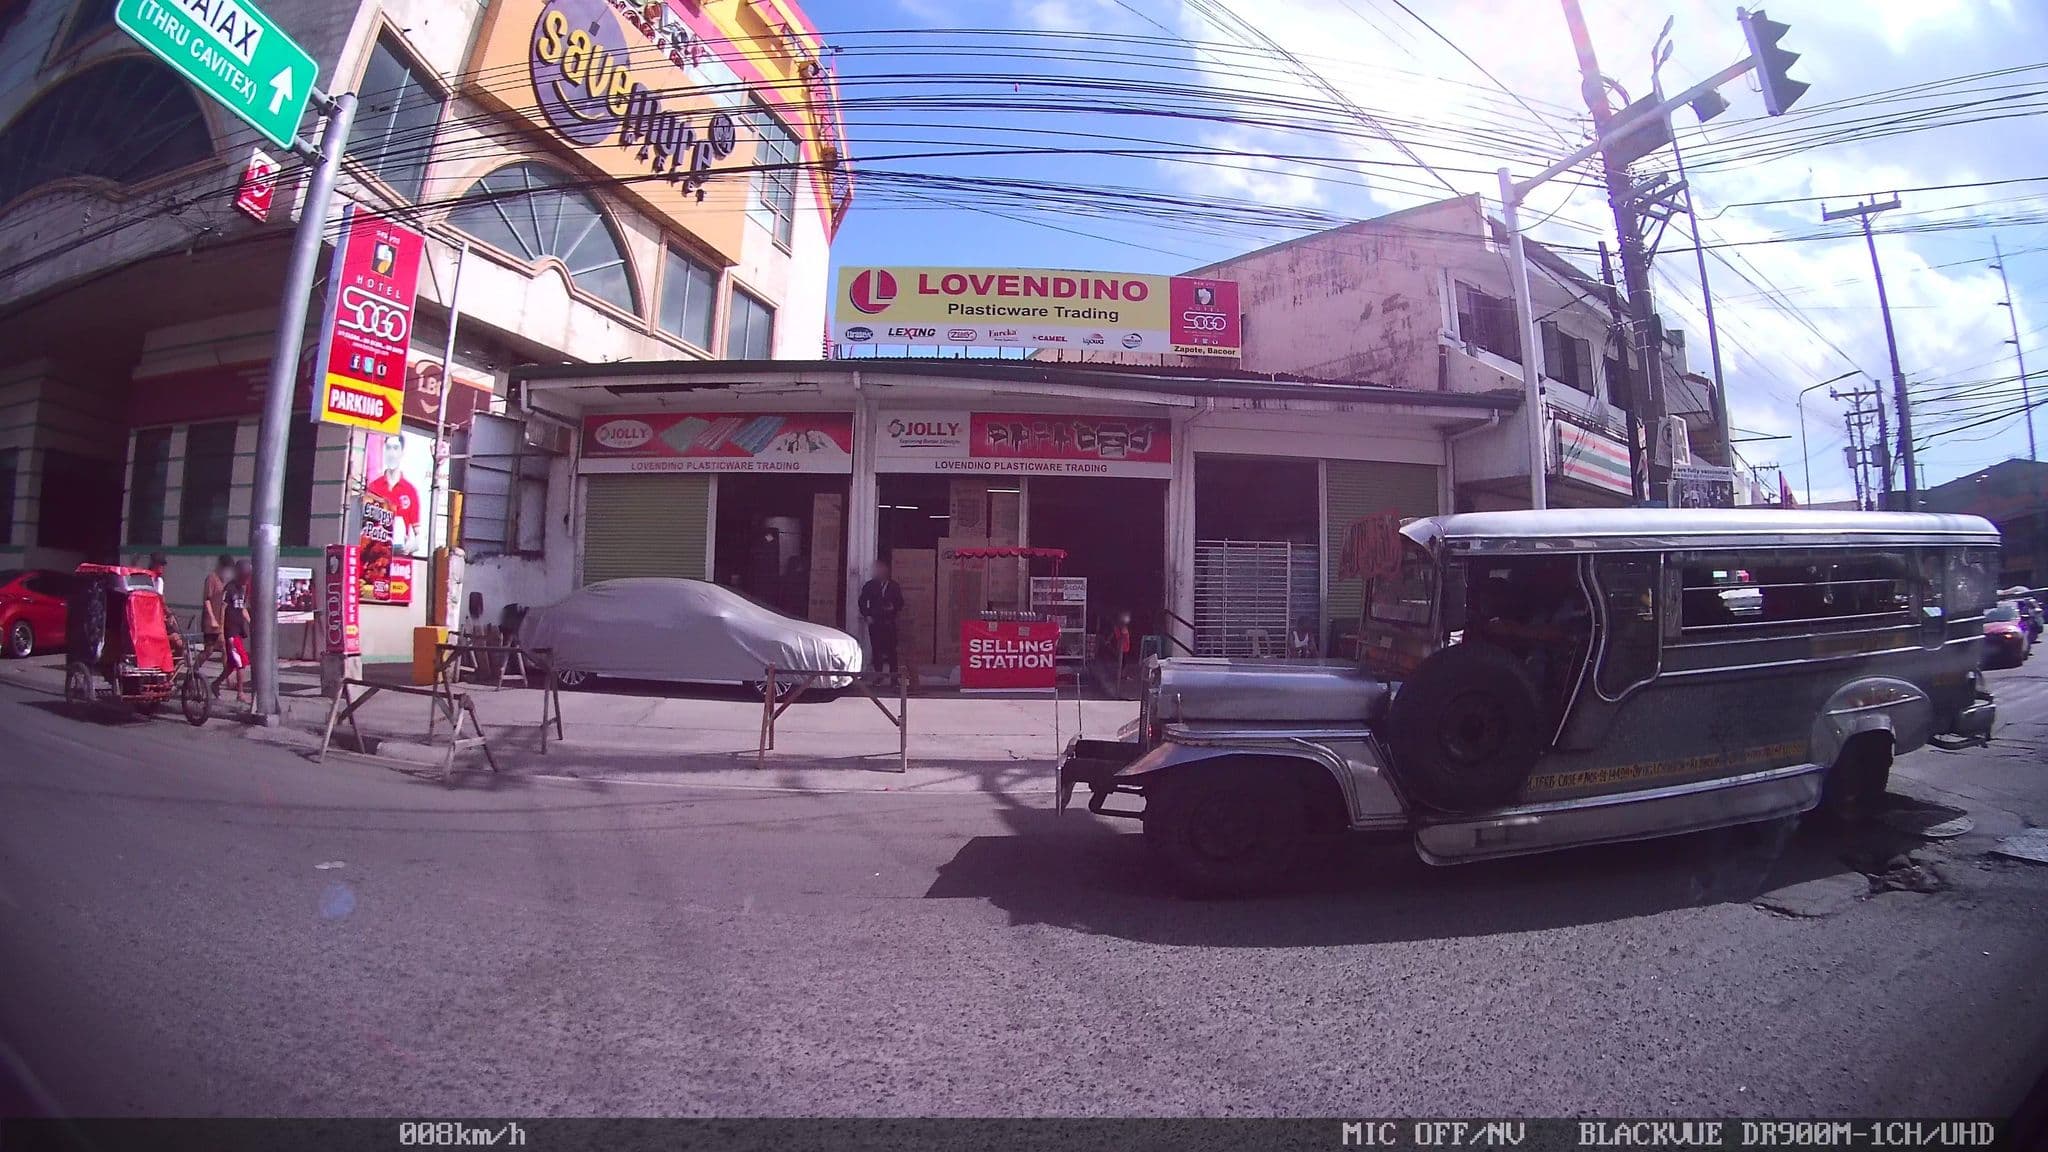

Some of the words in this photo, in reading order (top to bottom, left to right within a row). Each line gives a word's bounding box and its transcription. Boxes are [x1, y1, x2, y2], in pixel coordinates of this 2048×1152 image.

[182, 0, 258, 56] AIAX
[136, 0, 191, 46] (THRU
[190, 37, 258, 105] CAVITEX)
[355, 273, 401, 299] HOTEL
[918, 273, 1149, 302] LOVENDINO
[338, 286, 409, 342] SOGO
[947, 303, 1049, 319] Plasticware
[1054, 307, 1119, 323] Trading
[1183, 311, 1227, 331] SOGO
[888, 328, 936, 339] LEXING
[988, 328, 1017, 337] Eureka
[1174, 345, 1206, 355] Zapote,
[1207, 347, 1236, 356] Bacoor
[329, 388, 384, 418] PARKING
[610, 426, 648, 439] JOLLY
[904, 421, 960, 437] JOLLY
[631, 462, 683, 471] LOVENDINO
[686, 462, 753, 471] PLASTICWARE
[756, 461, 800, 471] TRADING
[935, 460, 991, 471] LOVENDINO
[994, 461, 1062, 472] PLASTICWARE
[1065, 463, 1108, 474] TRADING
[364, 501, 394, 526] Crspy
[969, 639, 1054, 653] SELLING
[969, 653, 1054, 669] STATION
